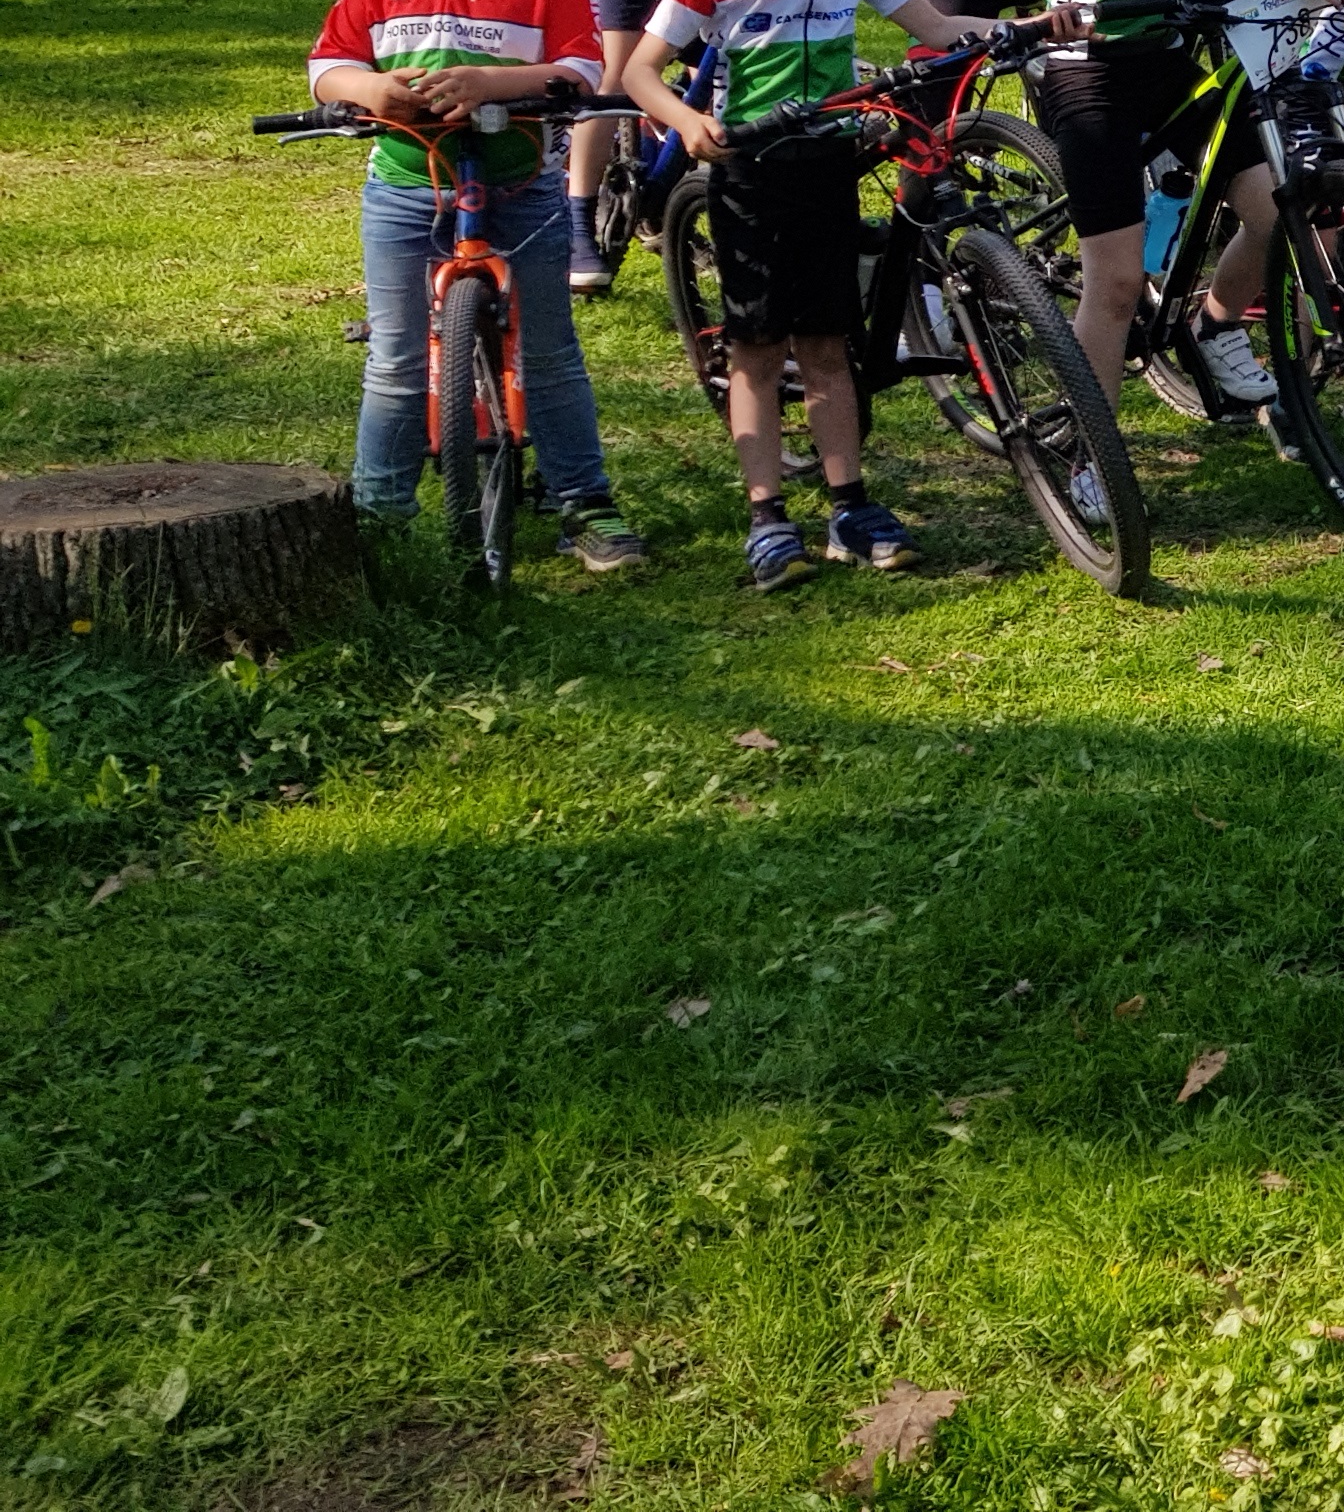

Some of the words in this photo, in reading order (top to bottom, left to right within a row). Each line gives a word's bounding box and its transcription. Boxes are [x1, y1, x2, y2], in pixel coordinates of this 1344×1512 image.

[386, 22, 432, 38] HORTEN
[434, 20, 452, 33] OG
[454, 24, 503, 41] OMEGN
